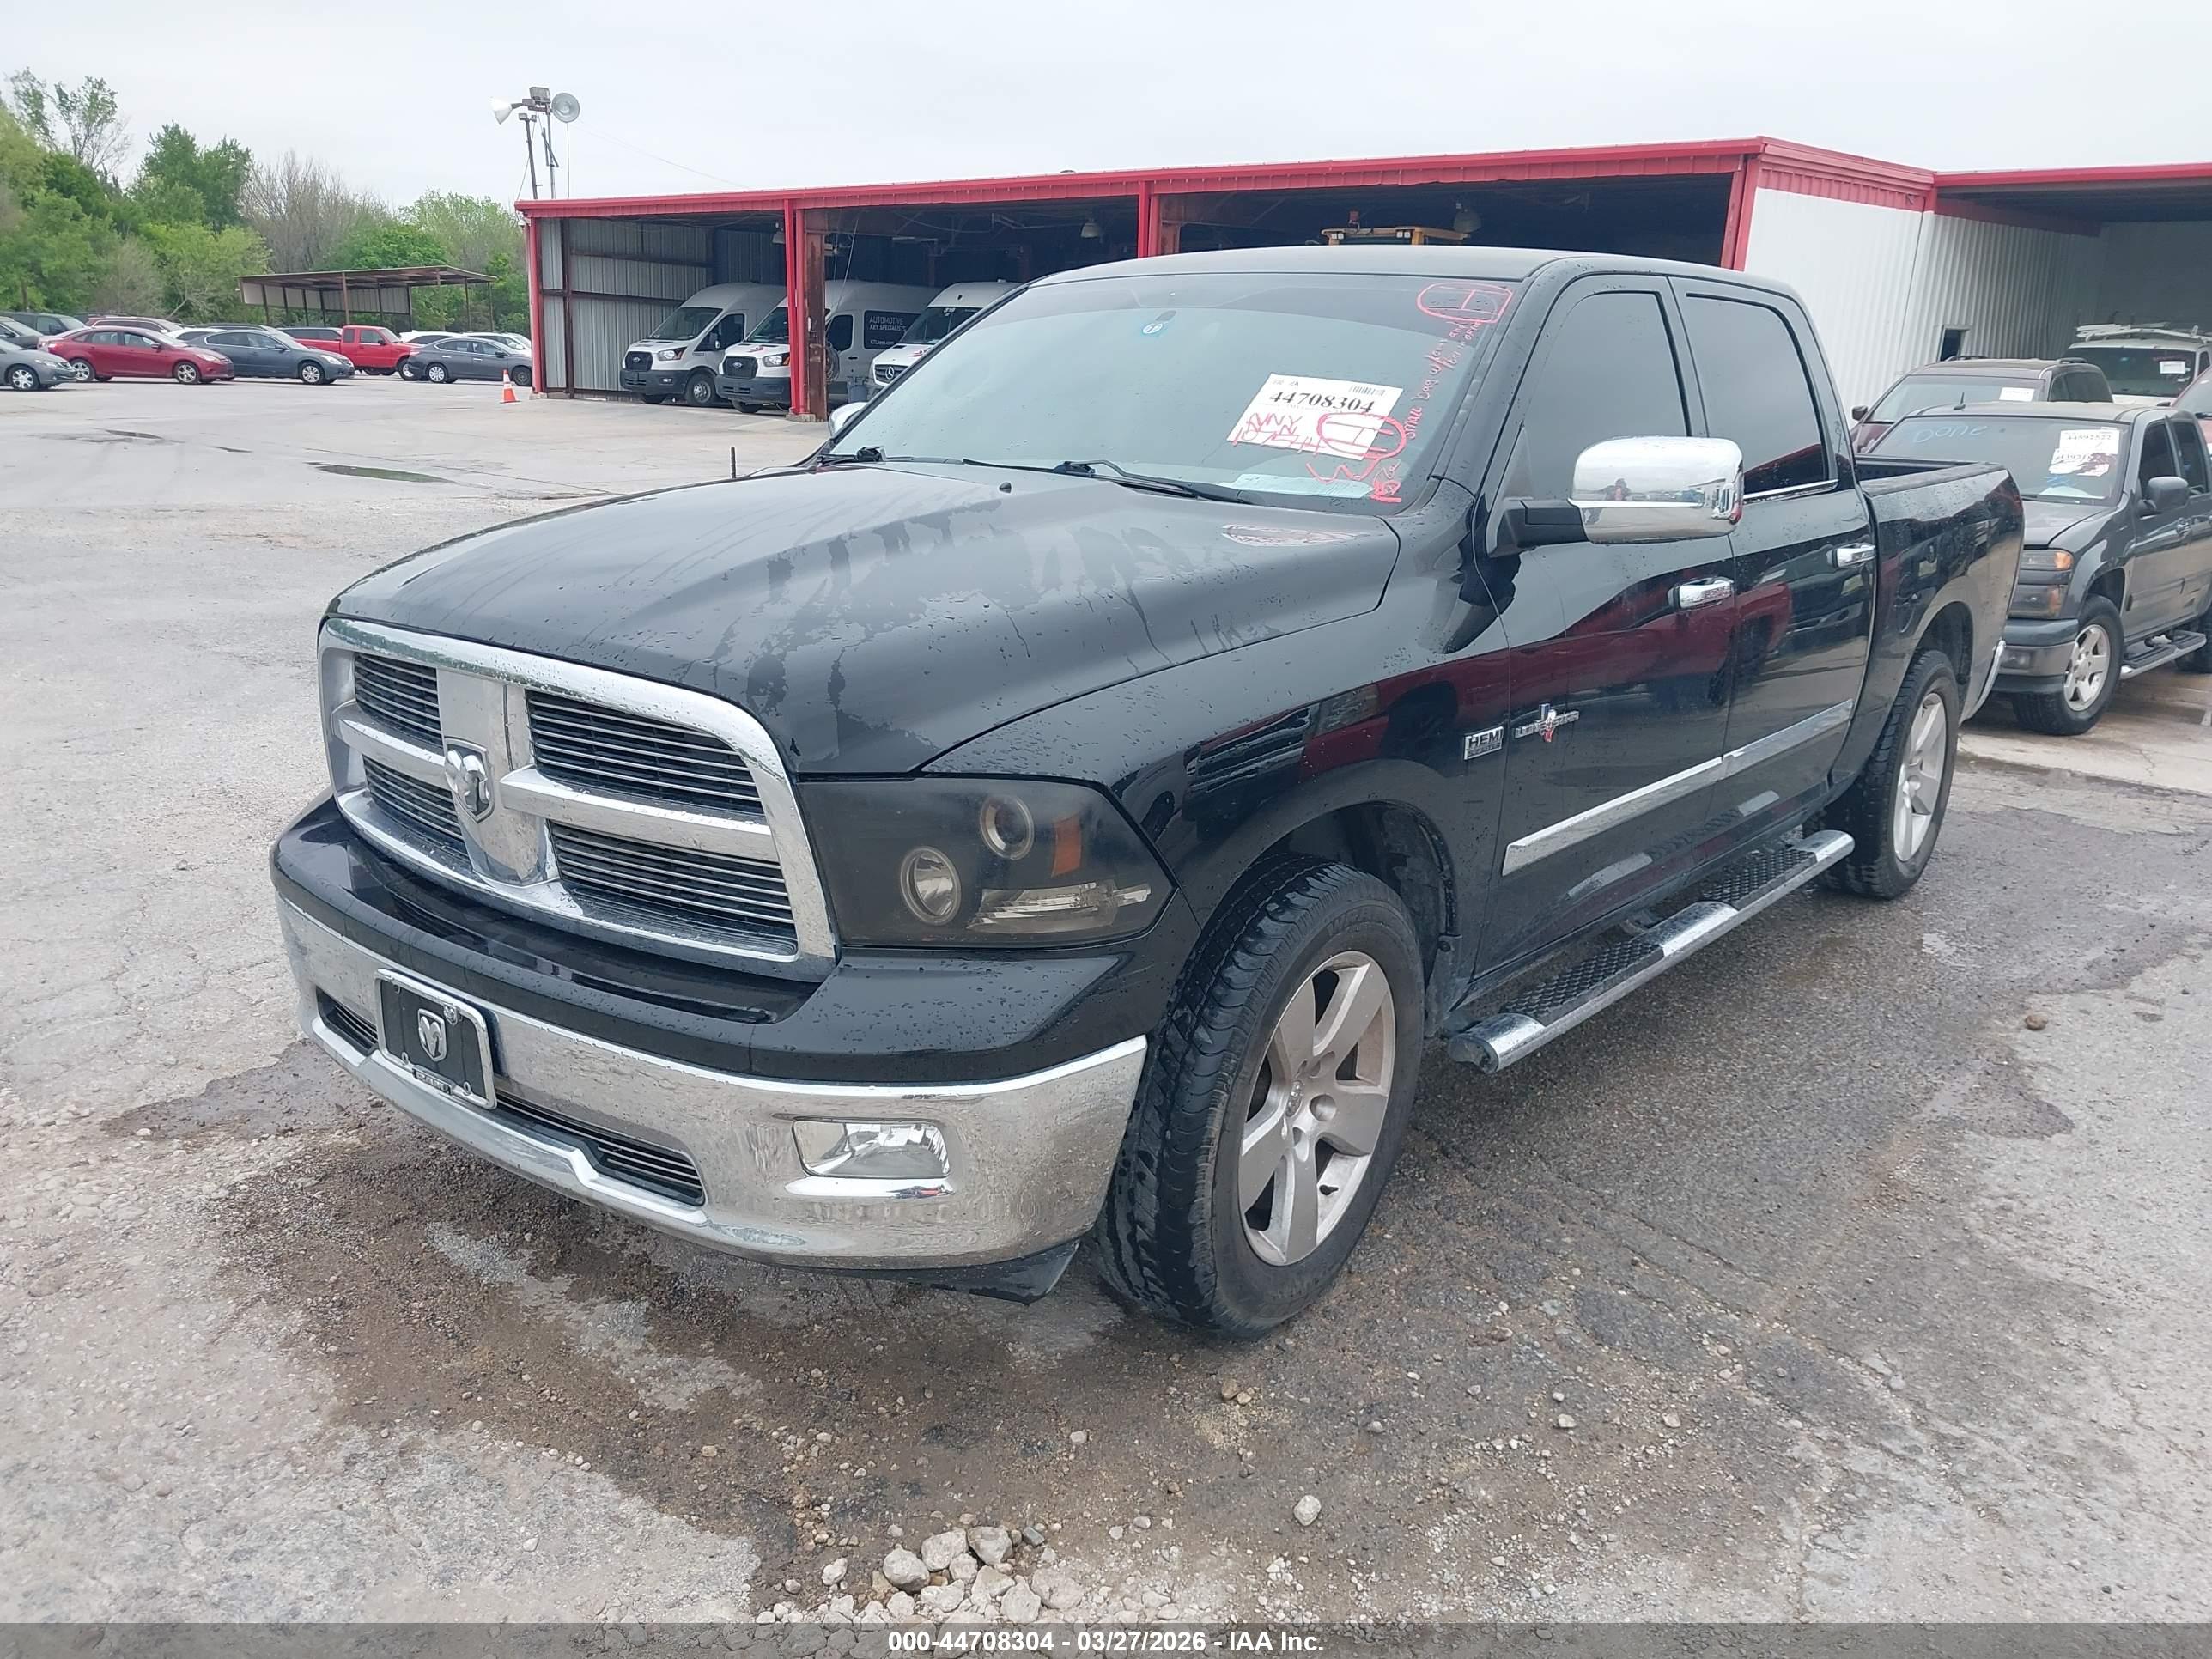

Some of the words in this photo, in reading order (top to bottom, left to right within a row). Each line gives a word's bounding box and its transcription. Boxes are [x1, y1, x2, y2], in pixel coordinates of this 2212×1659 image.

[869, 315, 904, 325] AUTOMOTIVE
[1269, 391, 1375, 413] 44708304
[1468, 726, 1504, 749] HEMI
